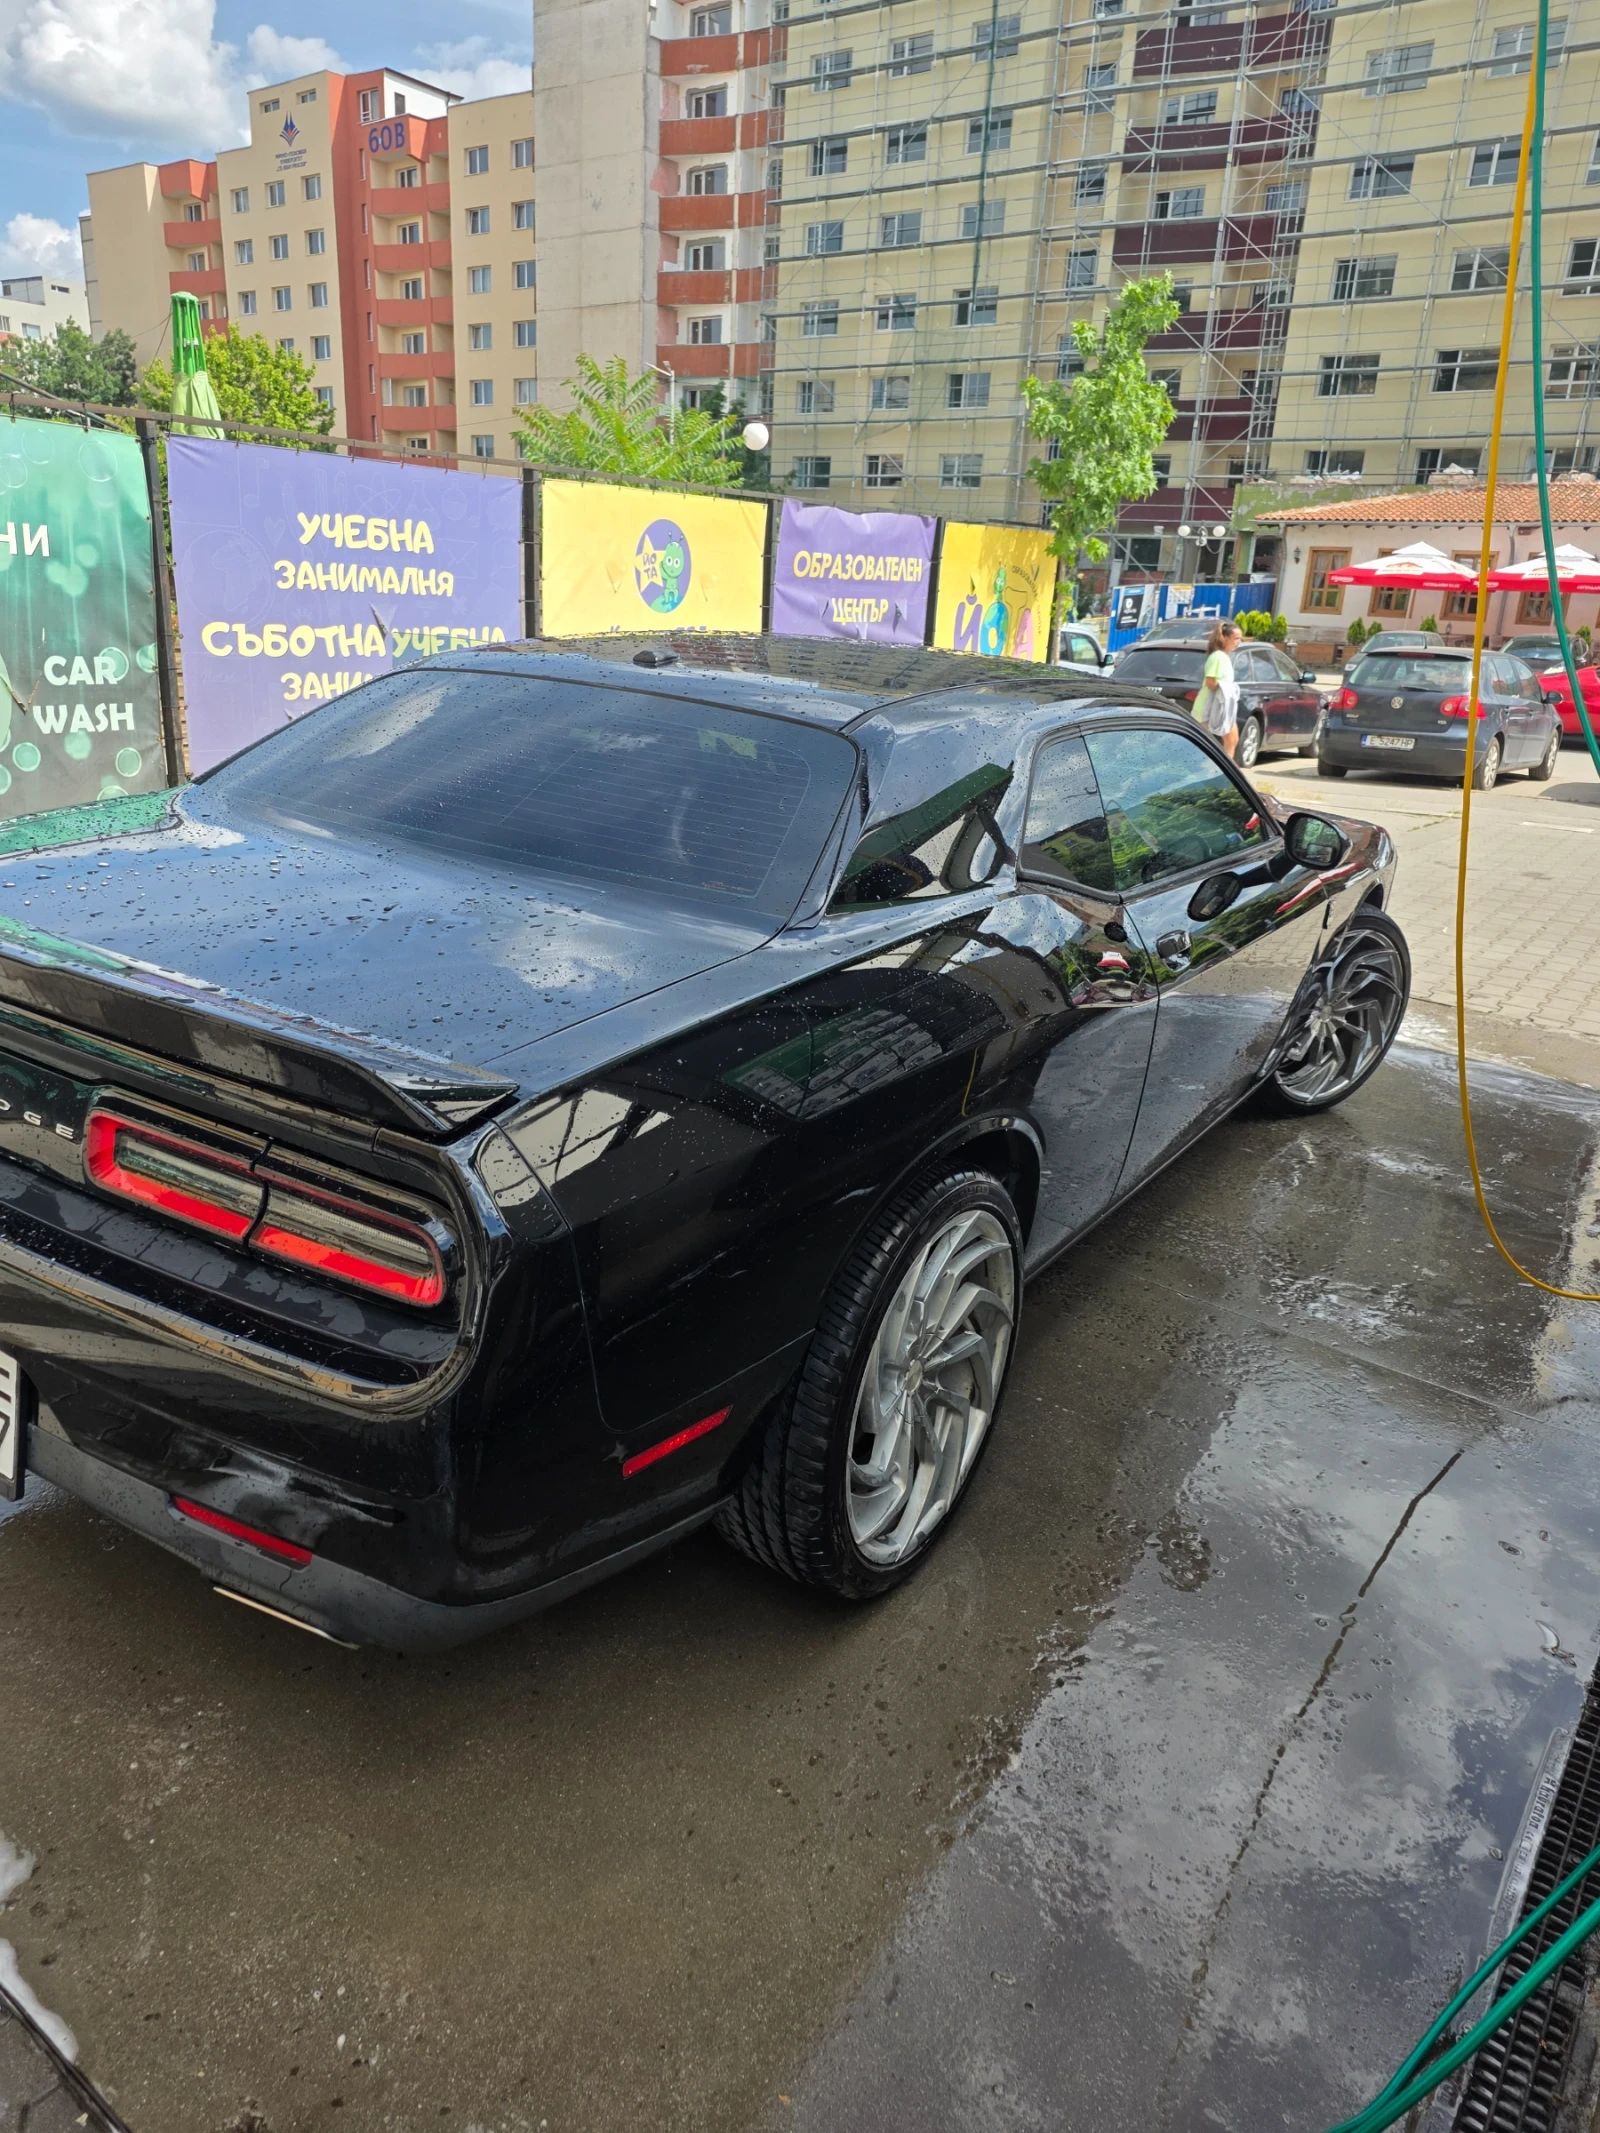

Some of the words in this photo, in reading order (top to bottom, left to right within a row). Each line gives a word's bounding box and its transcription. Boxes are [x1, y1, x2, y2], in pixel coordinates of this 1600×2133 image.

[297, 512, 434, 554] УЧЕБНА
[274, 560, 454, 597] ЗАНИМАЛНЯ
[793, 550, 923, 582] ОБРАЗОВАТЕЛЕН
[831, 598, 889, 626] ЦЕНТЪР
[201, 622, 386, 658] СЪБОТНА
[43, 655, 119, 686] CAR
[32, 702, 136, 734] WASH
